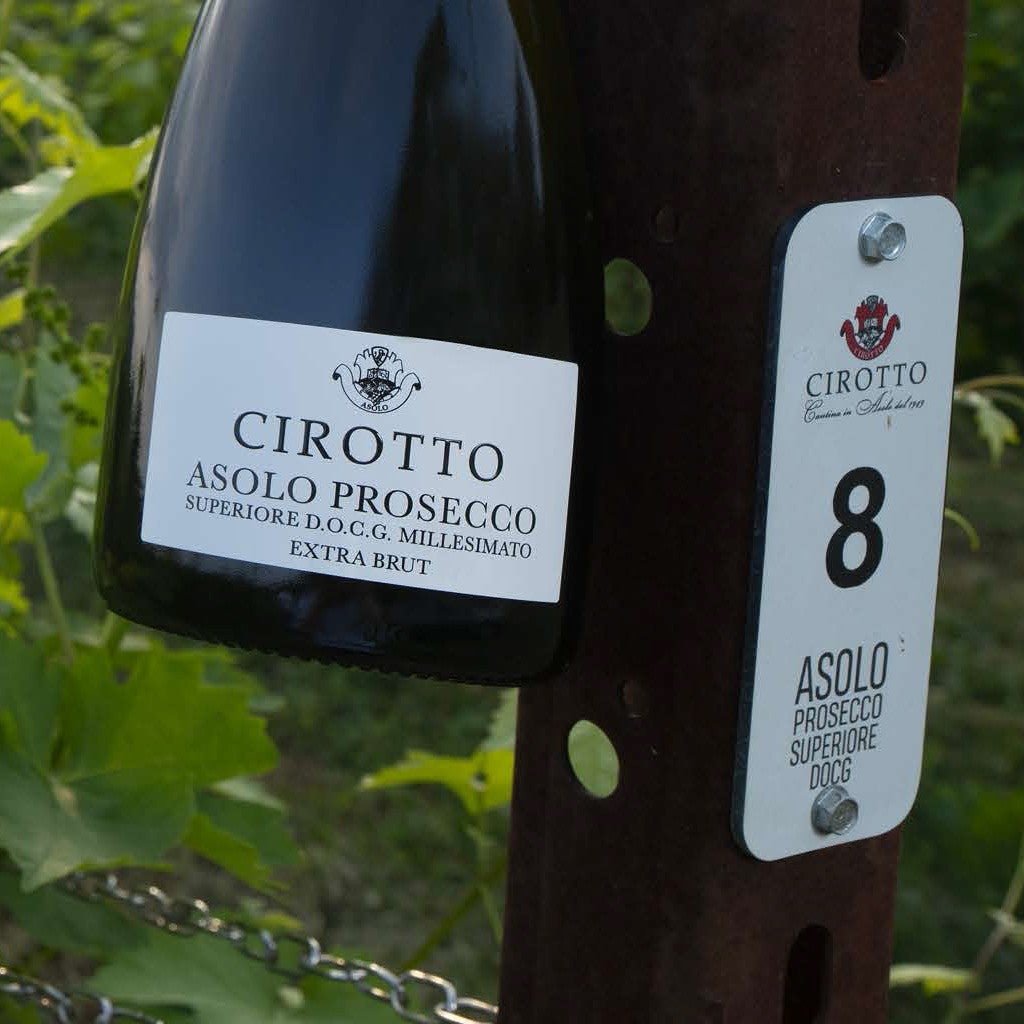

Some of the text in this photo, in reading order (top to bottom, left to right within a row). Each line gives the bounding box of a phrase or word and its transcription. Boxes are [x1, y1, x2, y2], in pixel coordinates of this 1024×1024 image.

[806, 361, 927, 397] CIROTTO
[361, 402, 389, 412] ASOLO
[233, 410, 504, 482] CIROTTO
[185, 461, 537, 535] ASOLO PROSECCO
[185, 494, 532, 559] SUPERIORE D.O.C.G. MILLESIMATO
[825, 466, 886, 589] 8
[289, 540, 431, 575] EXTRA BRUT
[795, 641, 888, 705] ASOLO
[793, 693, 883, 736] PROSECCO
[789, 723, 878, 767] SUPERIORE
[809, 757, 852, 790] DOCG
